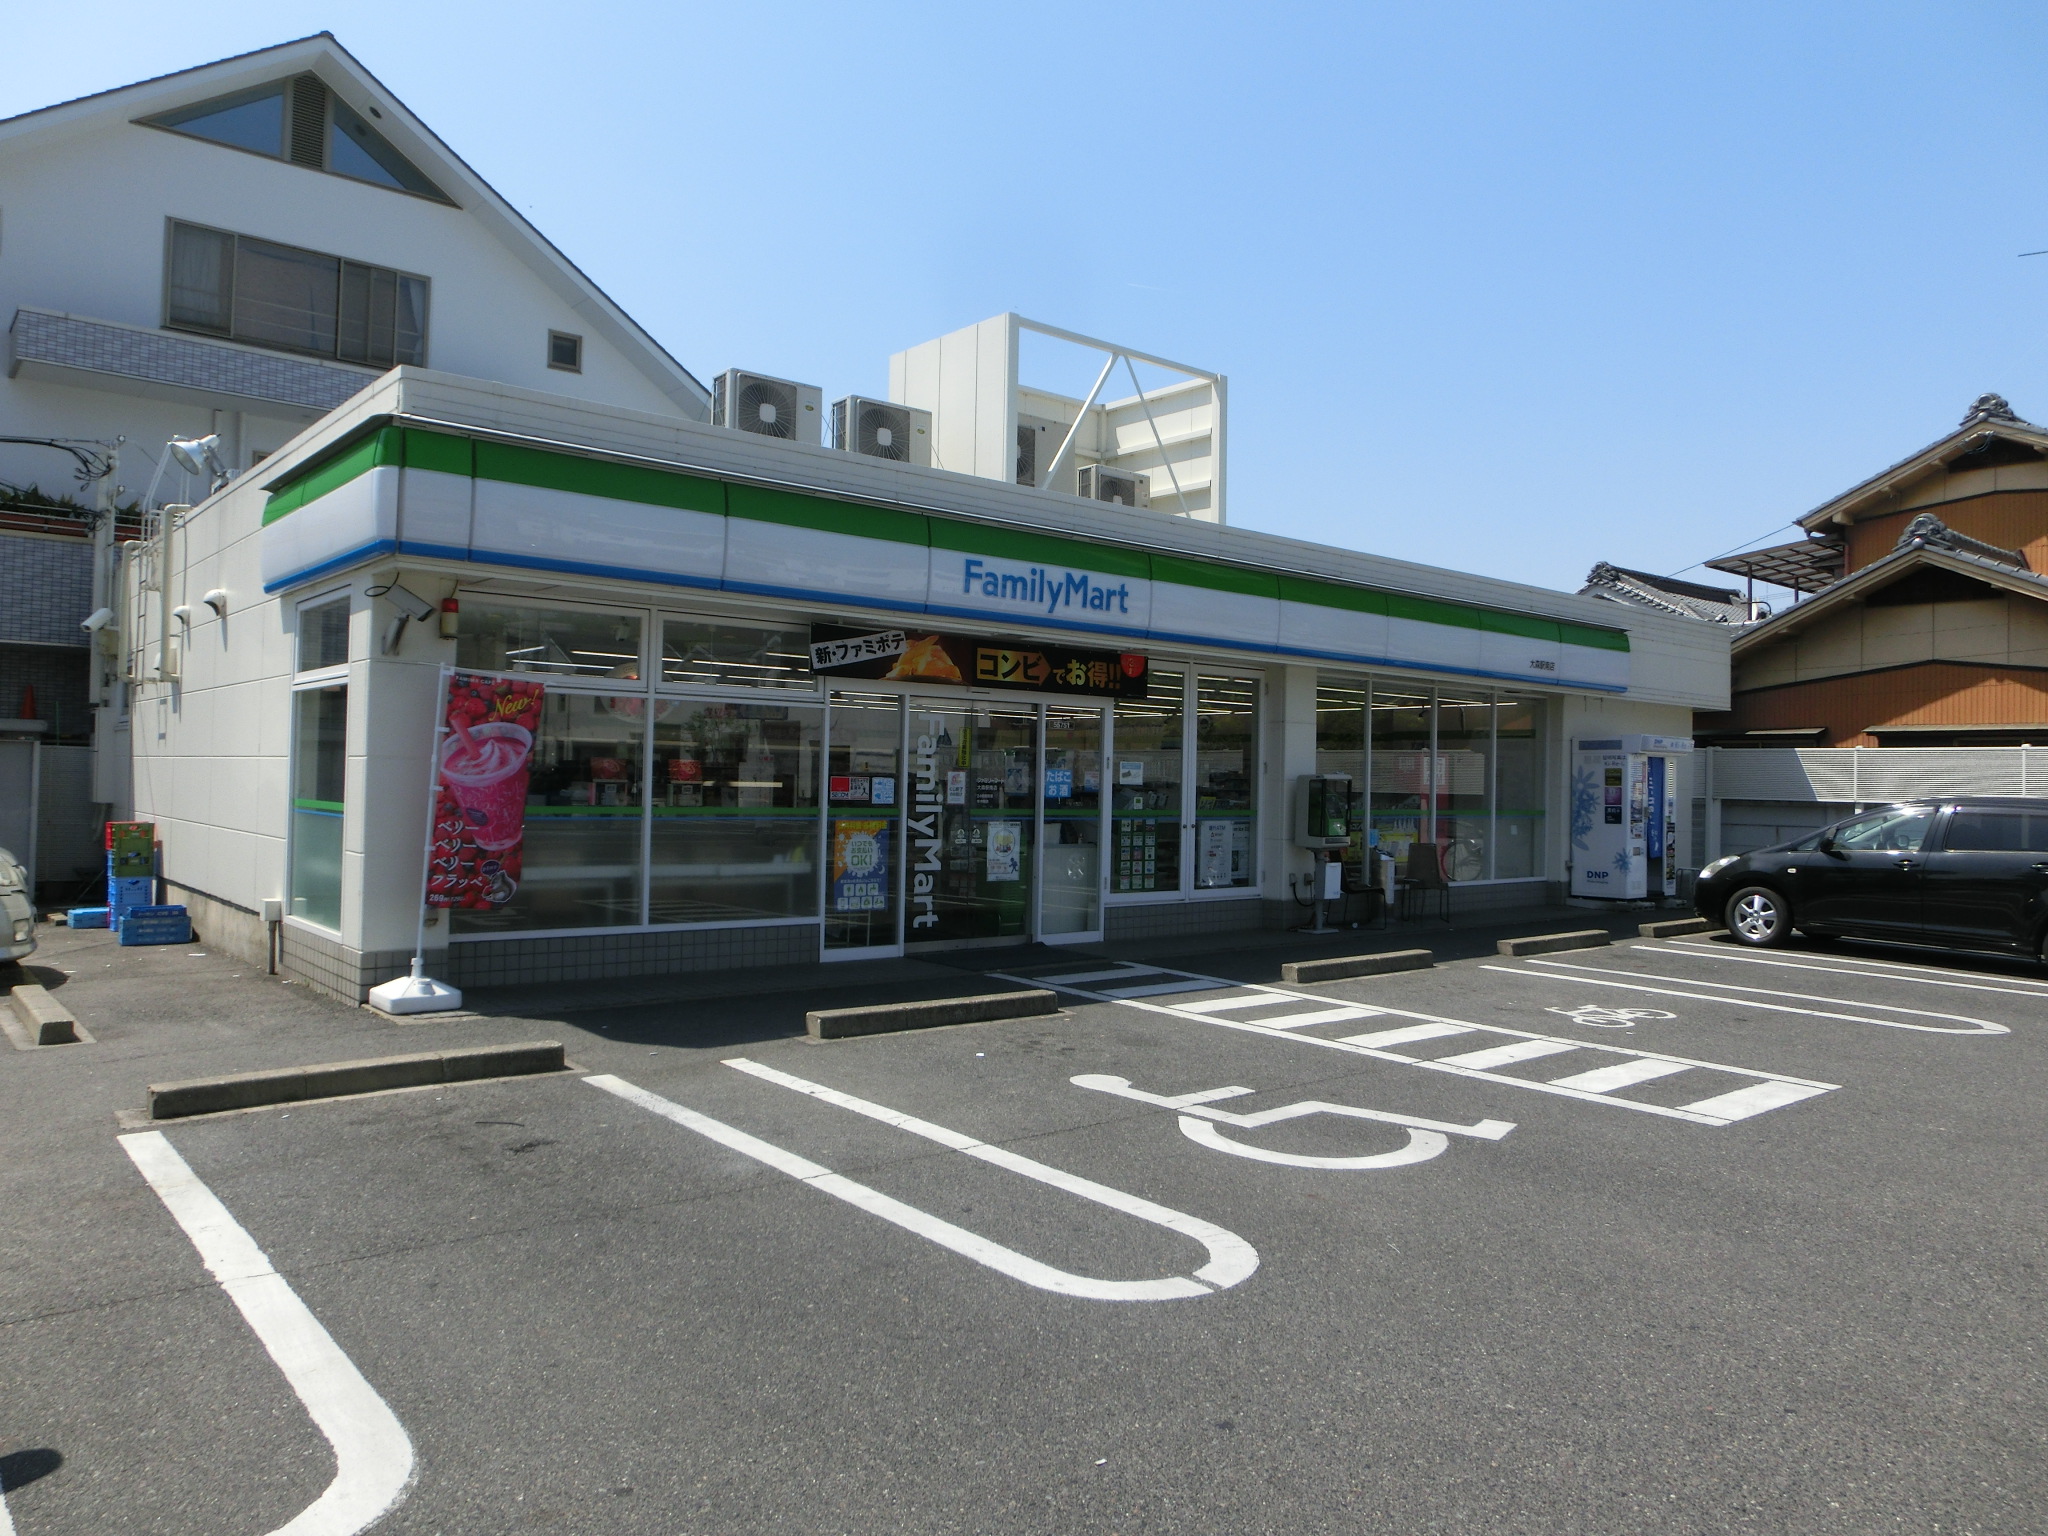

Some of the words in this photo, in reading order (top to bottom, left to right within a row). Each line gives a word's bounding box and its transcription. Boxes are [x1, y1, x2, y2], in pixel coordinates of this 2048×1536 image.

[963, 558, 1129, 614] FamilyMart
[814, 632, 905, 666] 新・ファミポテ
[488, 689, 540, 721] New!
[1046, 771, 1071, 782] たばこ
[1048, 784, 1069, 796] お酒
[437, 820, 480, 835] ベリー
[907, 713, 945, 929] FamilyMart
[435, 838, 477, 853] ベリー
[433, 856, 475, 871] ベリー
[851, 855, 873, 866] OK!
[431, 873, 483, 888] フラッペ
[1586, 870, 1609, 880] DNP
